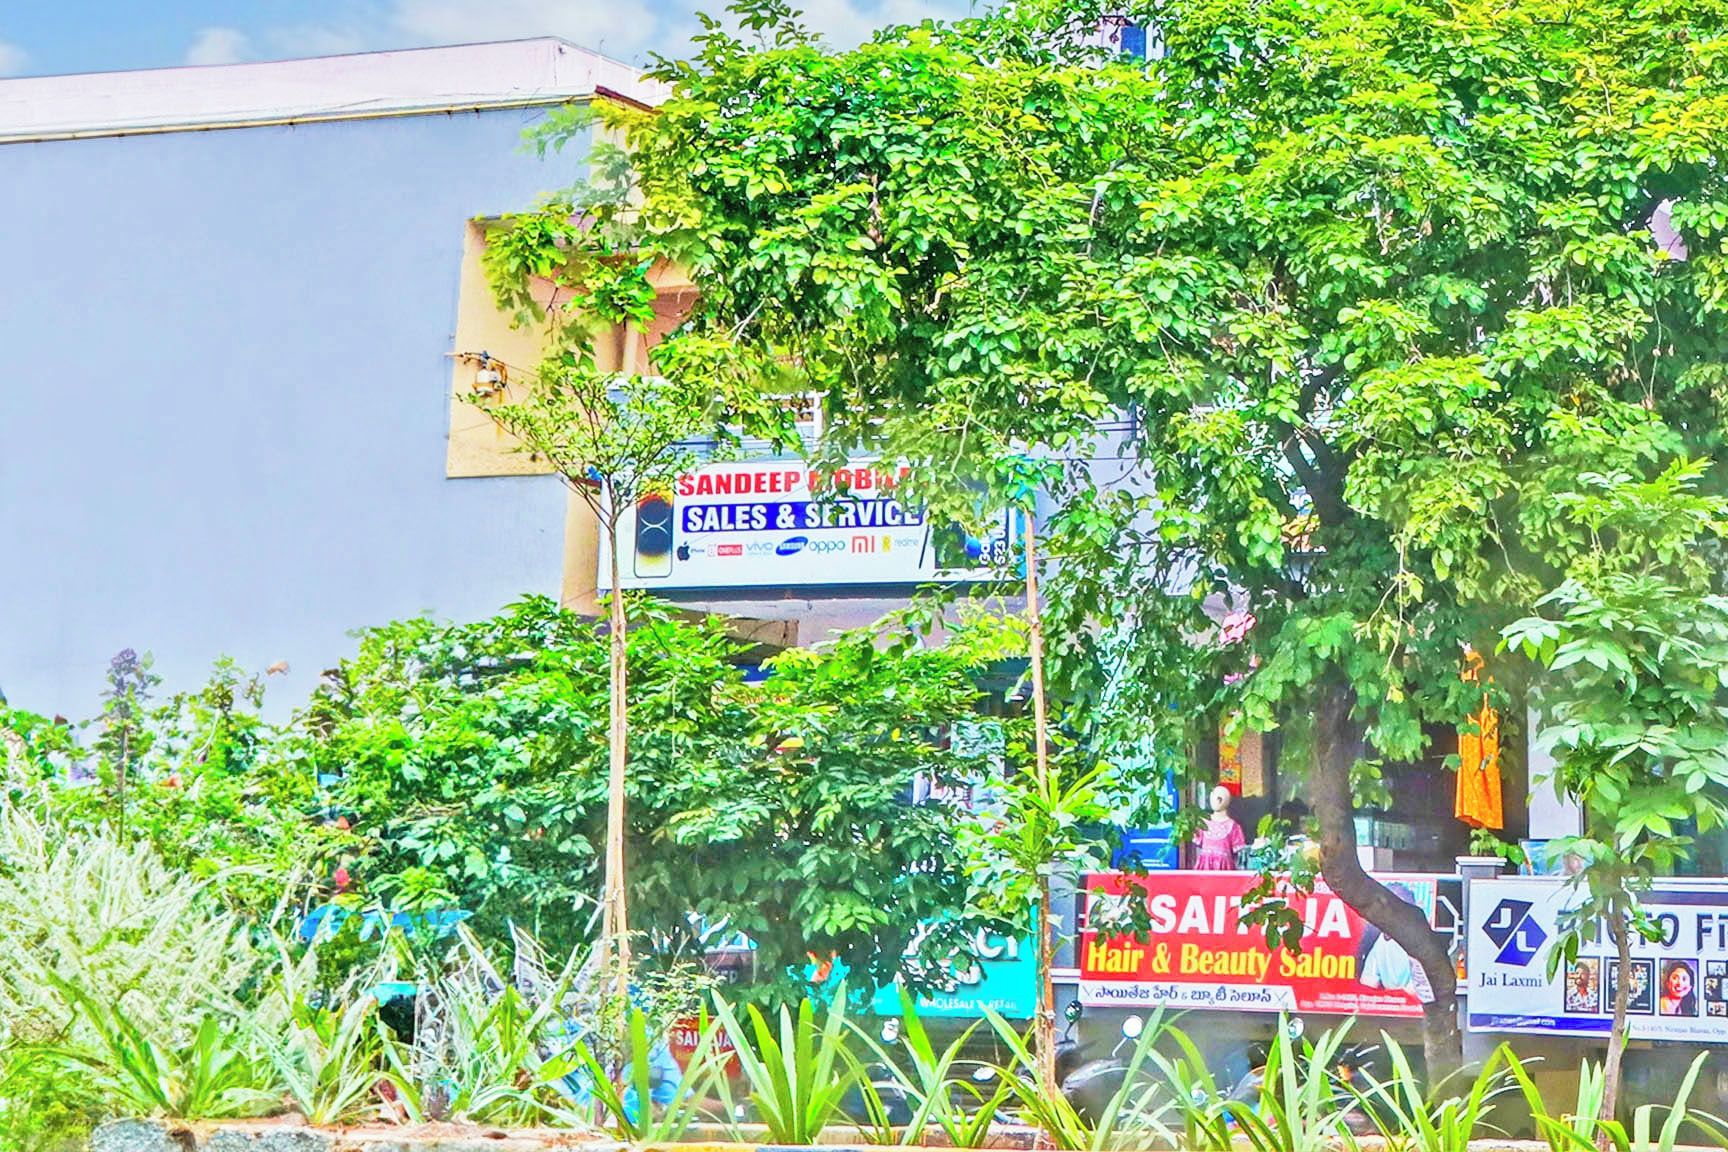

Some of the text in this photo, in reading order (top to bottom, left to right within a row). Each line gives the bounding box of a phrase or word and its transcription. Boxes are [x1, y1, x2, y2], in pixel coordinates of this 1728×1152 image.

[678, 470, 800, 496] SANDEEP
[687, 504, 767, 532] SALES
[775, 503, 796, 529] &
[1087, 942, 1356, 983] Hair & Beauty Salon
[1479, 972, 1542, 988] Jai Laxmi
